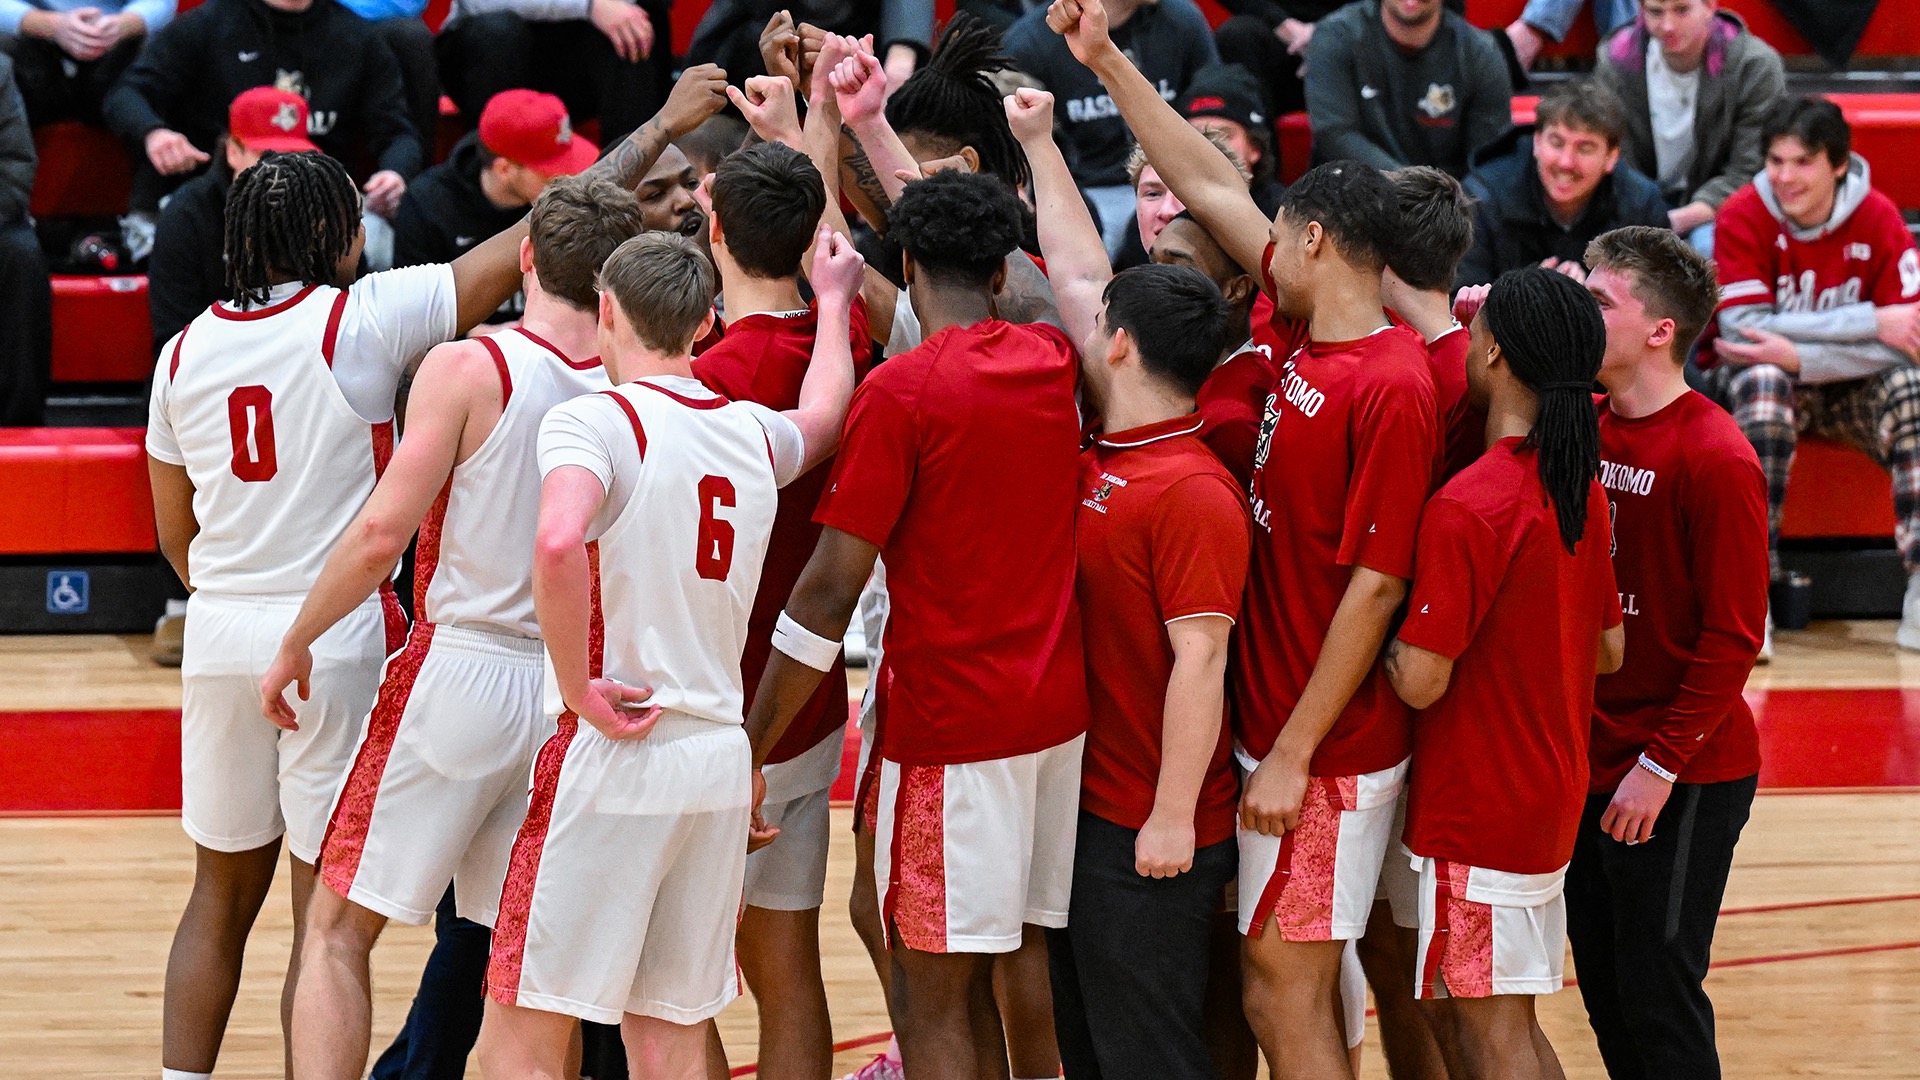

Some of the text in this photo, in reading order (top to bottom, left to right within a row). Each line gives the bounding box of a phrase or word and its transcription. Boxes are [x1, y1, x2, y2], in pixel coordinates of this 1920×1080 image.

[227, 384, 278, 483] 0
[1600, 459, 1656, 496] OKOMO
[695, 473, 737, 583] 6
